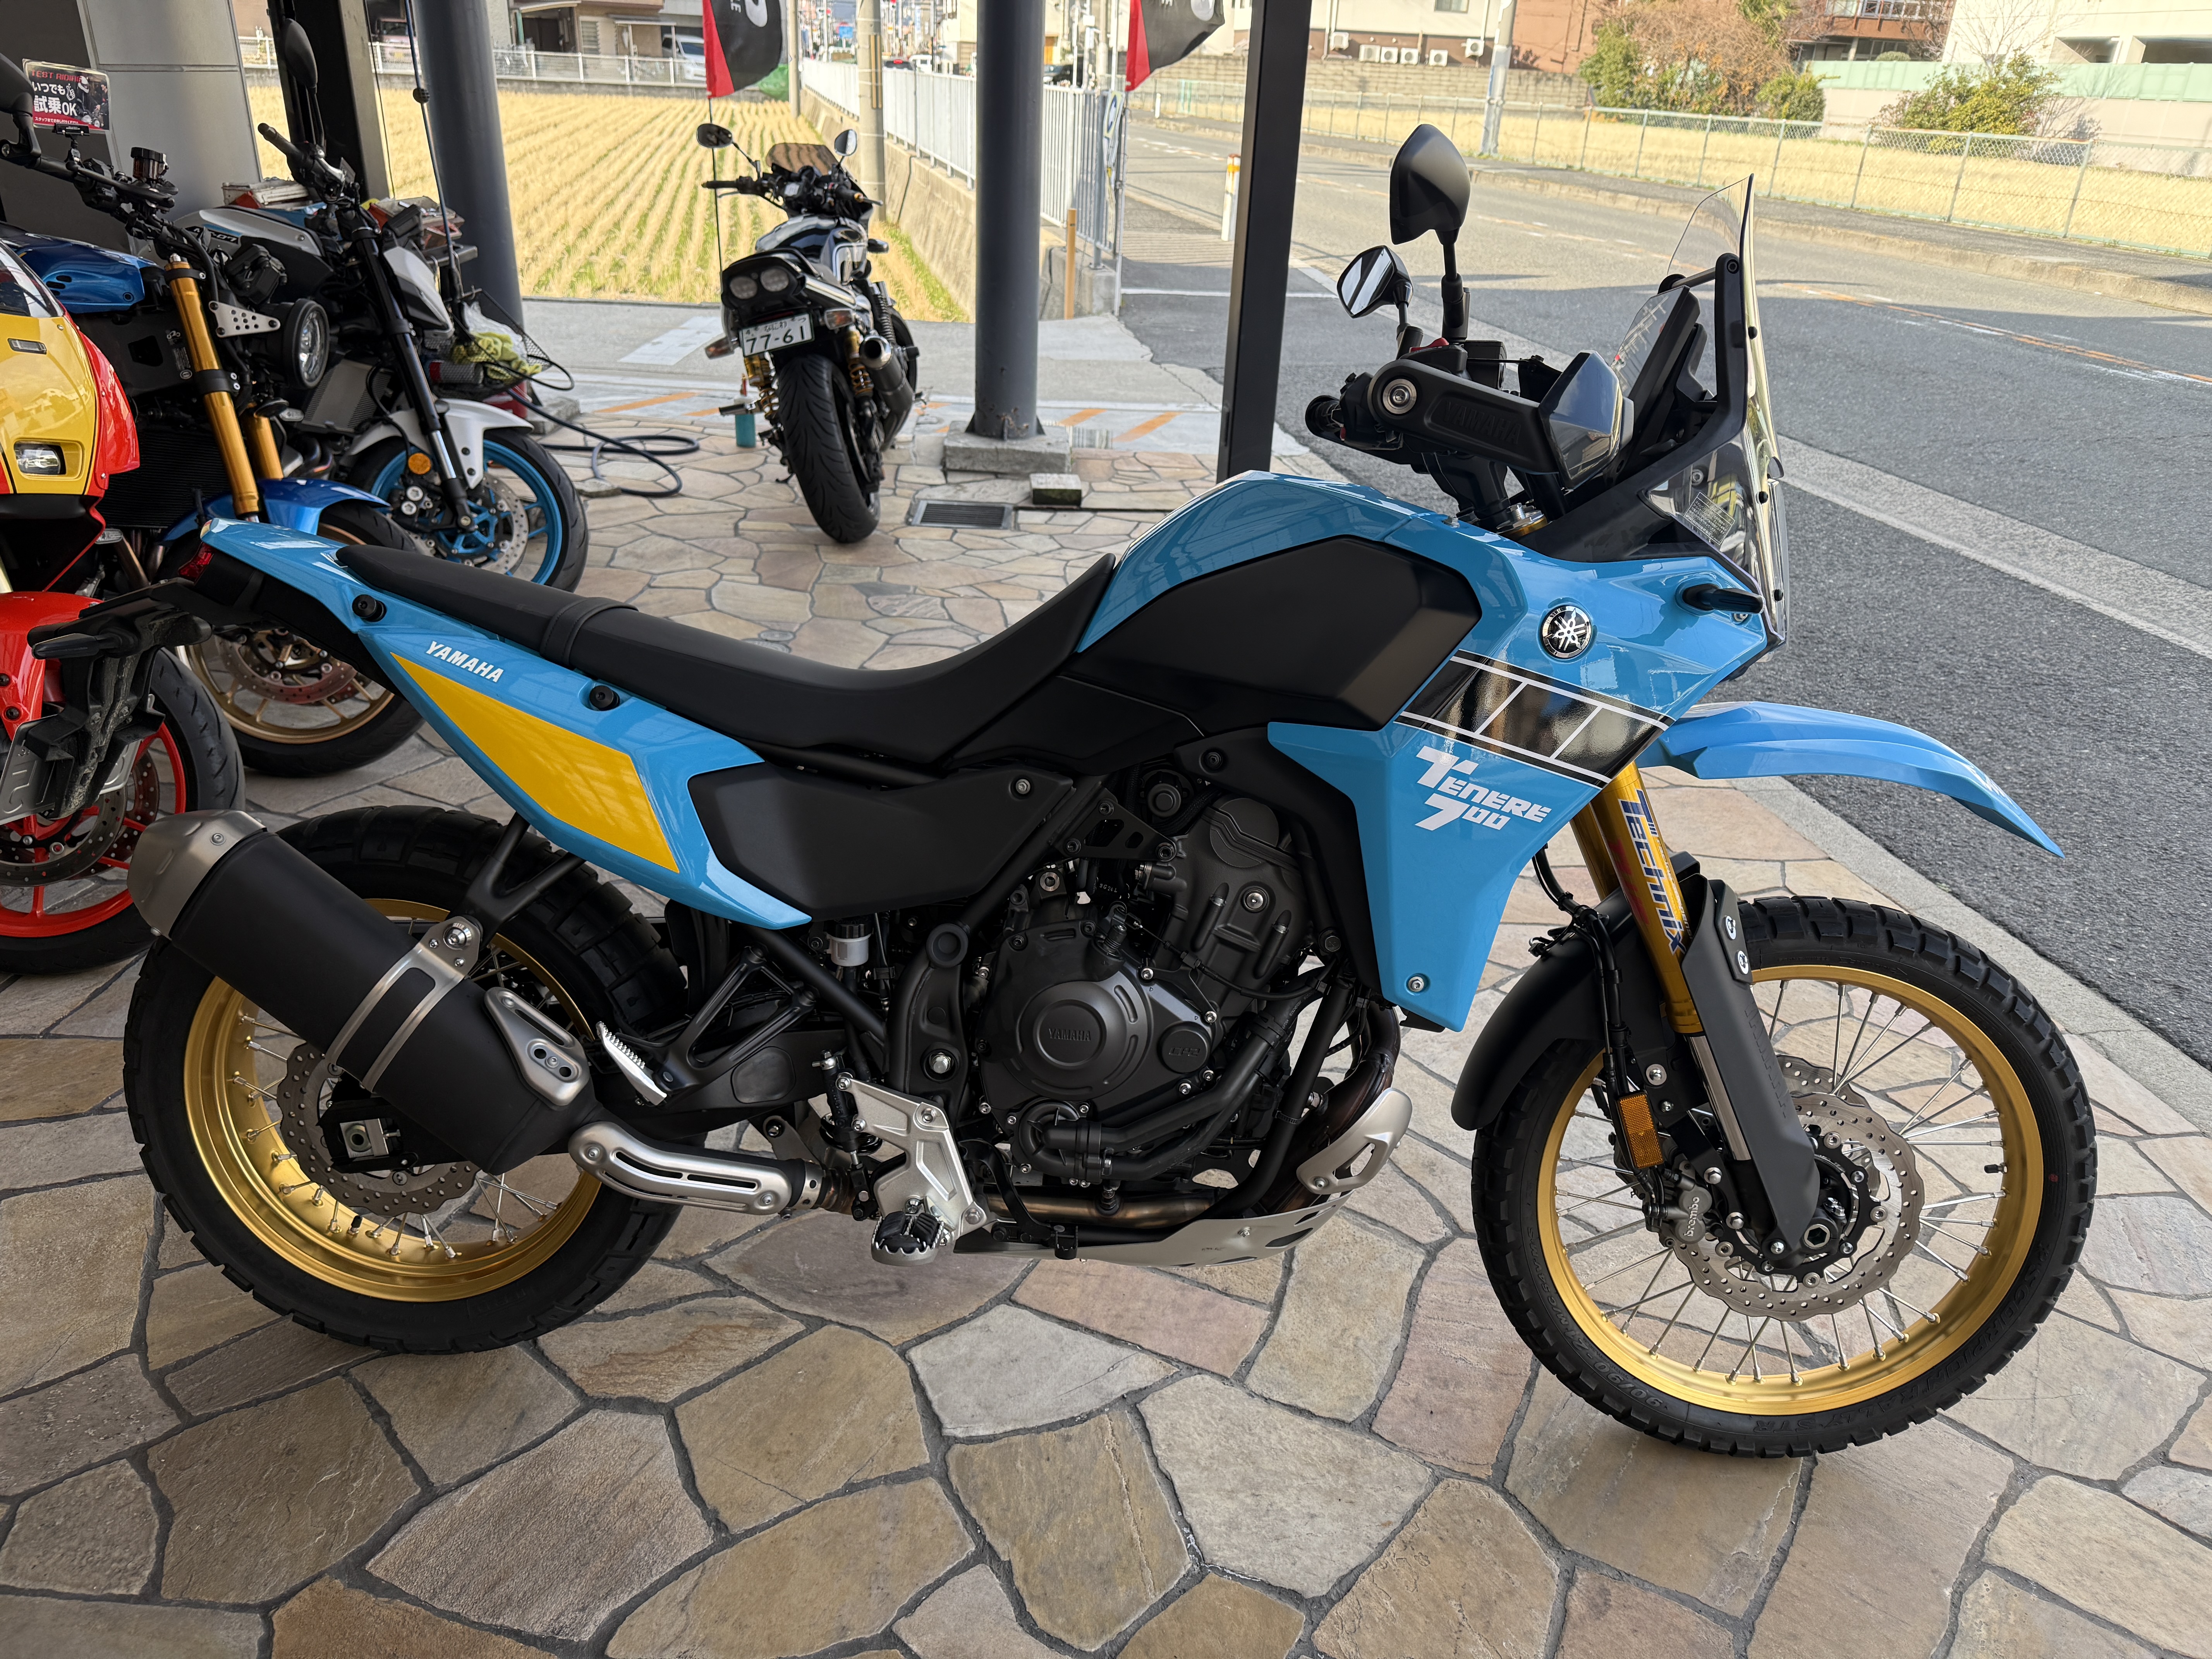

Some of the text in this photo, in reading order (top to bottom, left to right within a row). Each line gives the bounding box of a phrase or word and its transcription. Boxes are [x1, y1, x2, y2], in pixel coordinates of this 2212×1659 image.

[31, 70, 53, 79] TEST
[32, 81, 66, 95] いつでも
[746, 326, 805, 353] 77-61
[426, 641, 504, 682] YAMAHA
[1414, 793, 1511, 831] 700
[1049, 1028, 1091, 1041] YAMAHA
[1168, 1047, 1200, 1057] CP2
[1683, 1196, 1700, 1237] brembo
[1564, 1330, 1589, 1351] 21
[1928, 1269, 2042, 1392] SCORPION
[1594, 1362, 1663, 1407] 90/90
